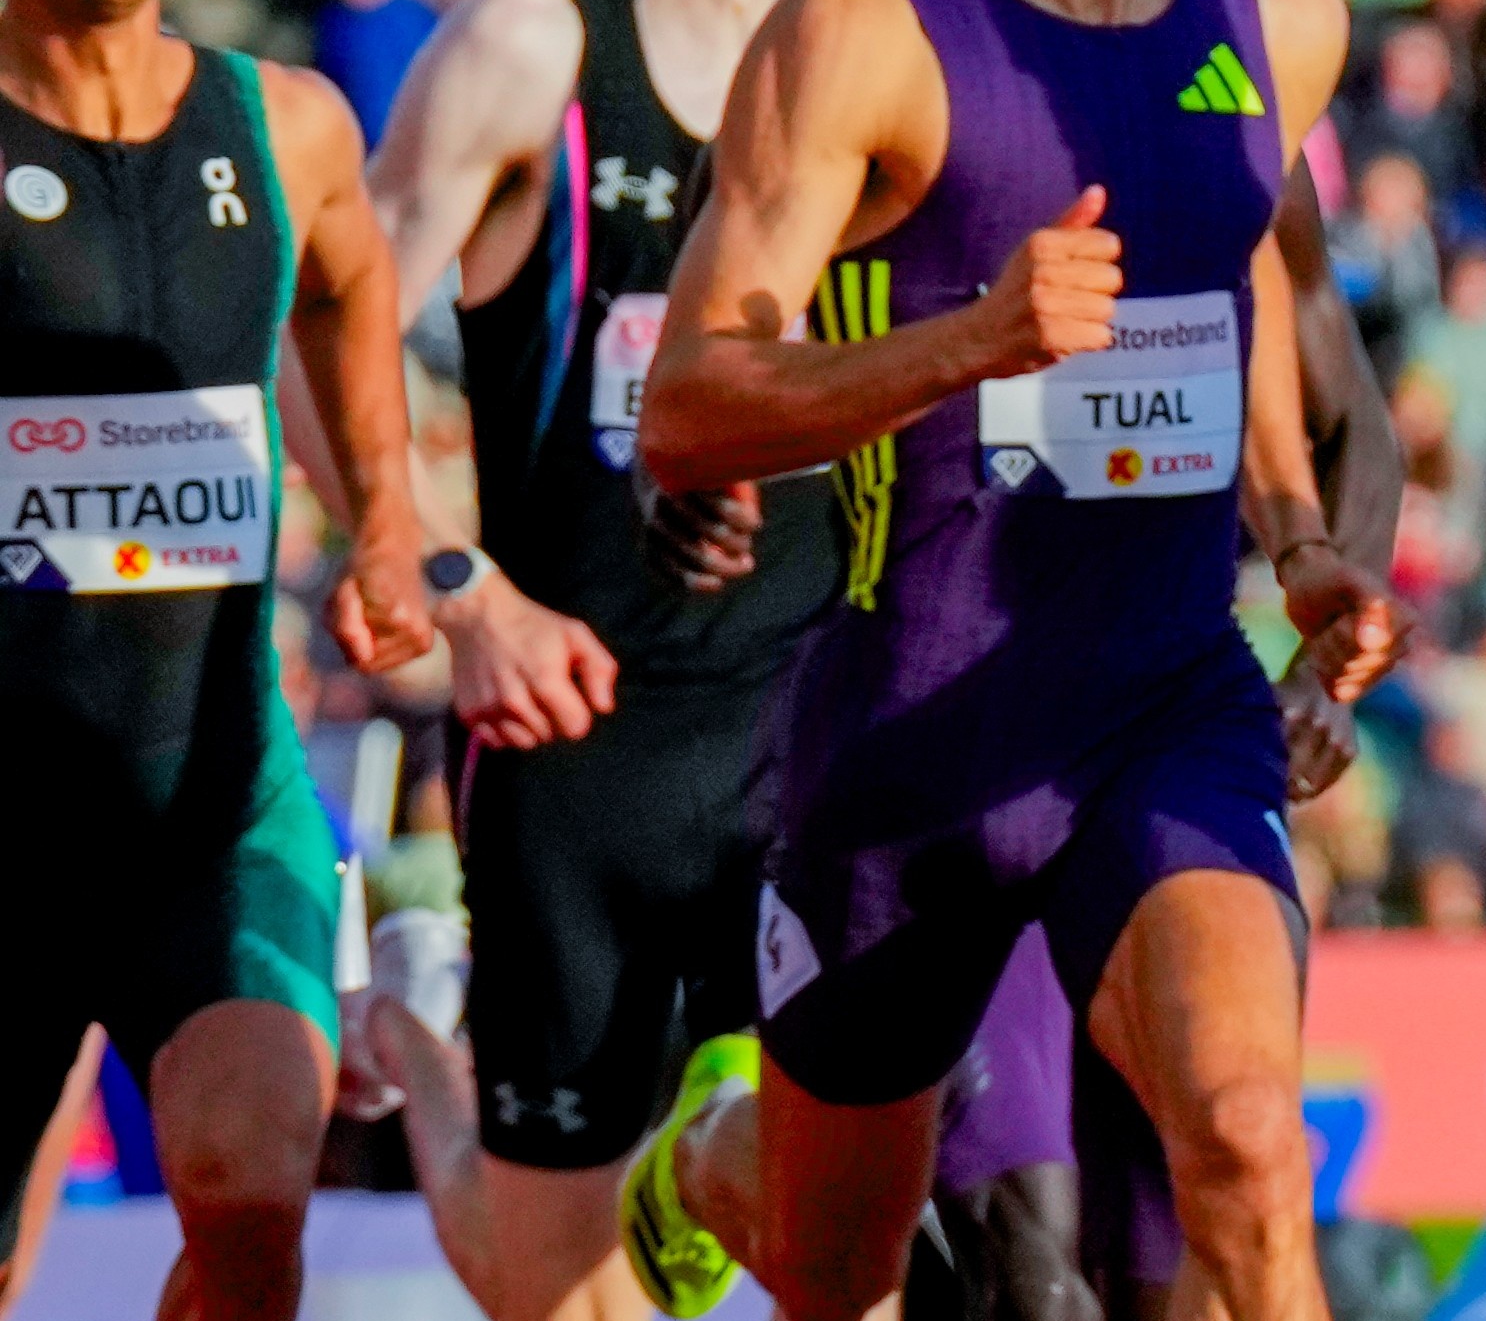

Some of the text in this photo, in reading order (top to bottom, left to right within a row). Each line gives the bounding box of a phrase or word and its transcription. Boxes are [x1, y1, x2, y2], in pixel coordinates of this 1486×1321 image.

[1082, 387, 1193, 430] TUAL
[100, 414, 251, 448] Storebrand
[1151, 451, 1214, 476] EXTRA
[14, 475, 257, 531] ATTAOUI
[161, 544, 241, 568] EXTRA
